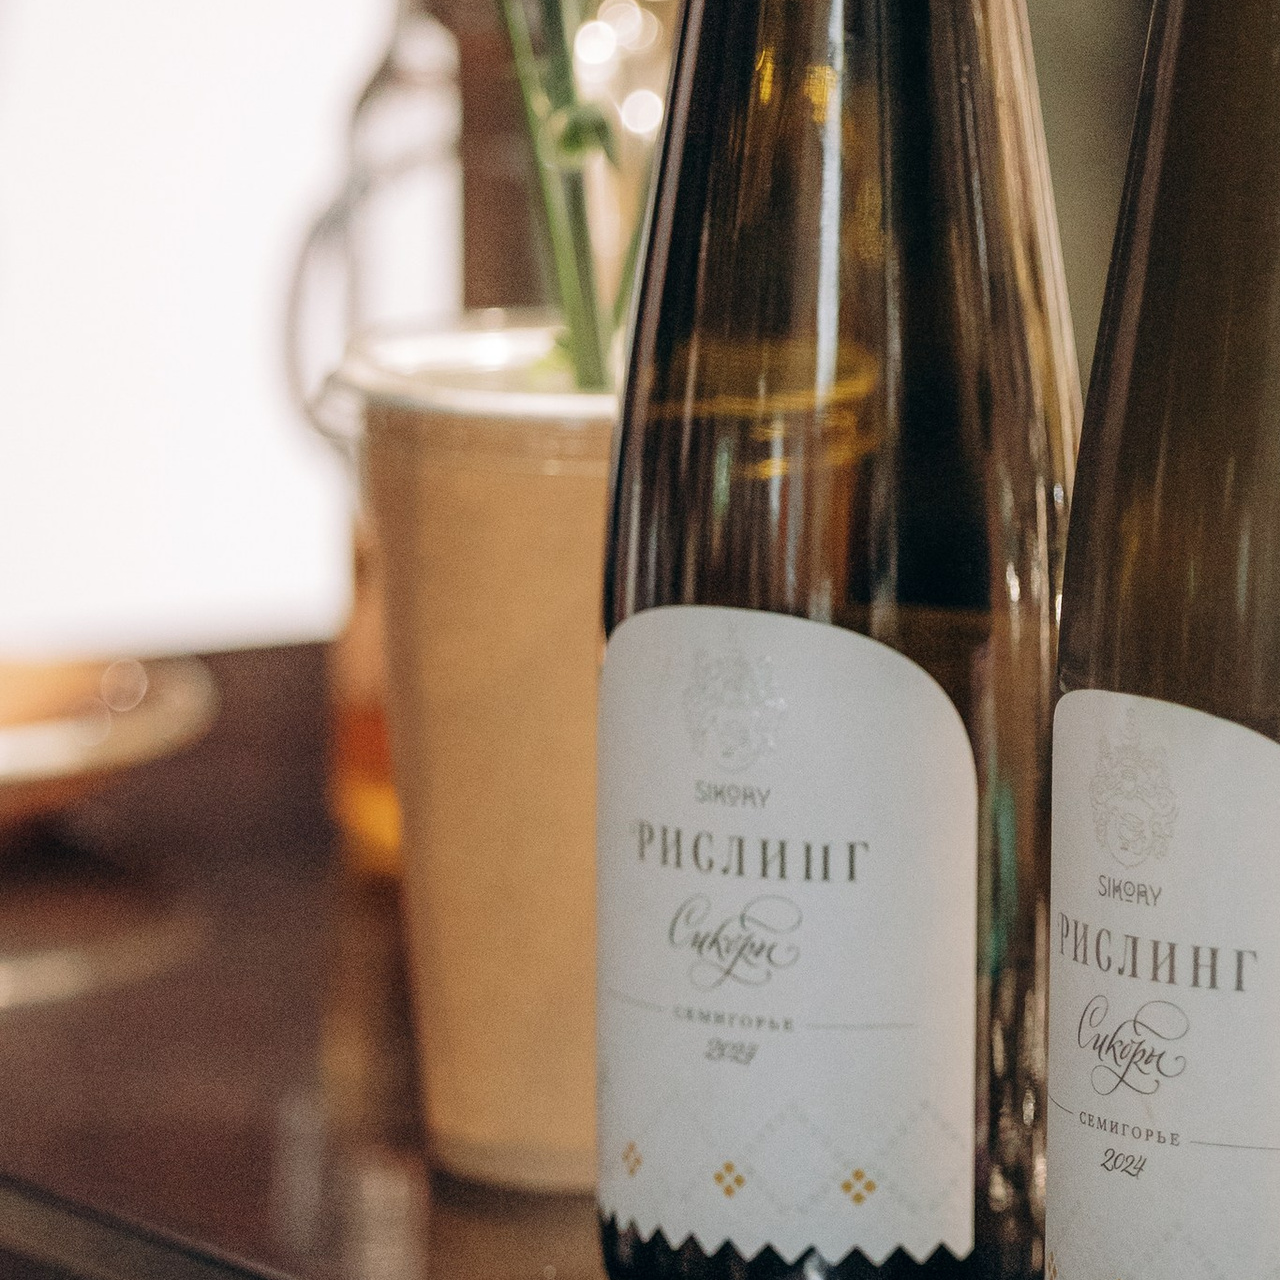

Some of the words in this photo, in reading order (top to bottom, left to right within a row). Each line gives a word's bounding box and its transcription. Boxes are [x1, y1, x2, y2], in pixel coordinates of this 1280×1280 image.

[631, 820, 870, 882] РИСЛИНГ
[1099, 874, 1162, 906] SIKORY
[1057, 911, 1258, 992] РИСЛИНГ
[1077, 995, 1190, 1096] Сикоры
[1079, 1111, 1181, 1146] СЕМИГОРЬЕ
[1100, 1148, 1148, 1180] 2024
